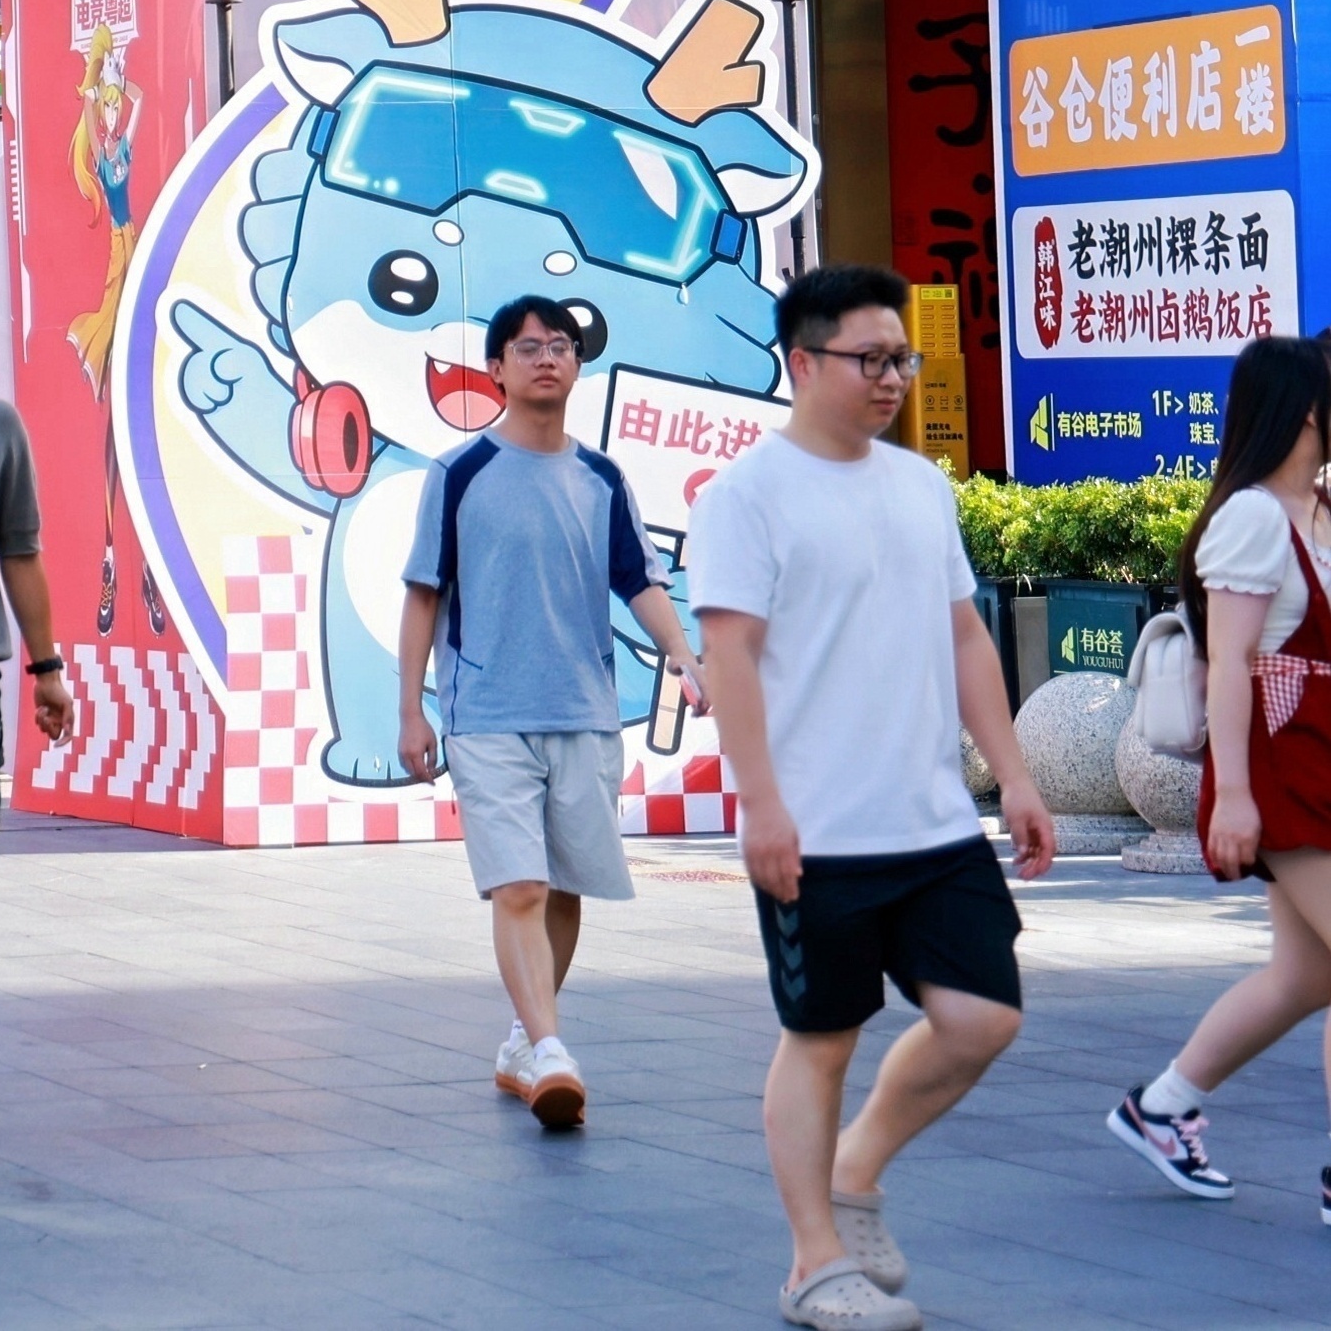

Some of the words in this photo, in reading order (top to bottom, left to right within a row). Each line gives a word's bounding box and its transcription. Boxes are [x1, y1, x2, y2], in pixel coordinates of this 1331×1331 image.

[1020, 41, 1222, 148] 谷仓便利店
[1068, 211, 1269, 280] 老潮州粿条面
[1037, 240, 1057, 332] 韩江味
[1070, 284, 1274, 345] 老潮州卤鹅饭店
[1057, 411, 1142, 439] 有谷电子市场
[1080, 627, 1125, 657] 有谷荟
[1082, 655, 1125, 670] YOUGUHUI
